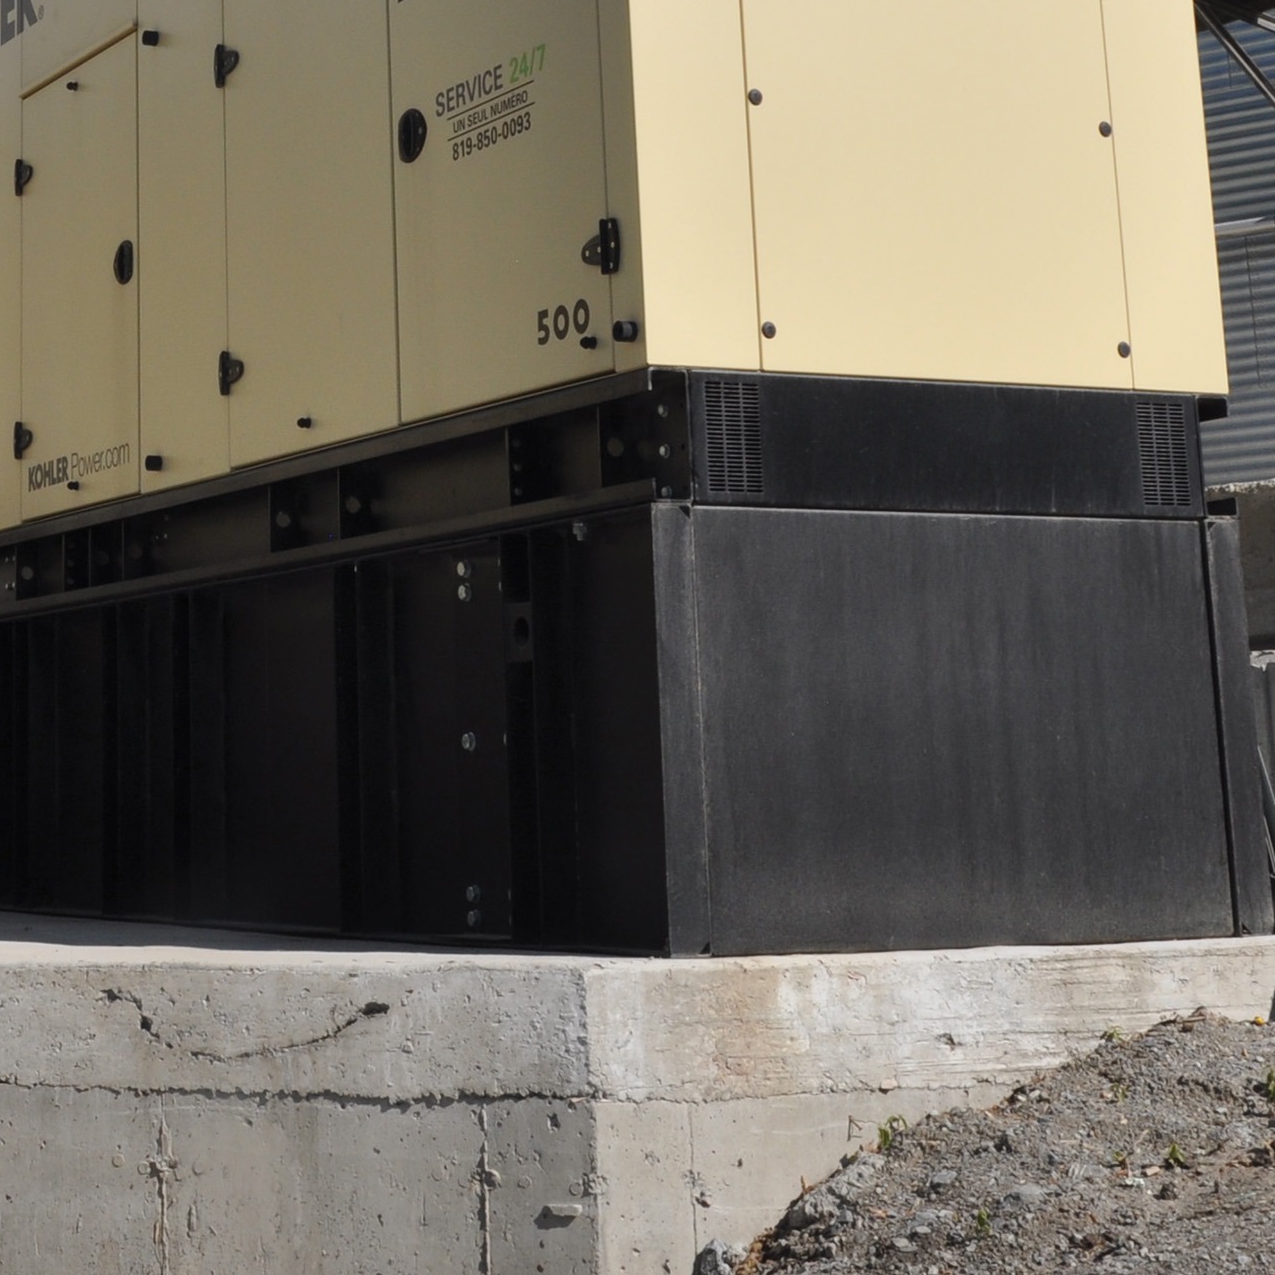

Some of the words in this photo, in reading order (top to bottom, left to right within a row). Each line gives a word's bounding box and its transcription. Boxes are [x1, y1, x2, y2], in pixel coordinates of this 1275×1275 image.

[435, 64, 503, 117] SERVICE
[509, 43, 546, 84] 24/7
[453, 117, 465, 133] UN
[467, 108, 488, 127] SEUL
[490, 90, 528, 116] NUMÉRO
[452, 112, 531, 161] 819-850-0093
[537, 298, 590, 346] 500
